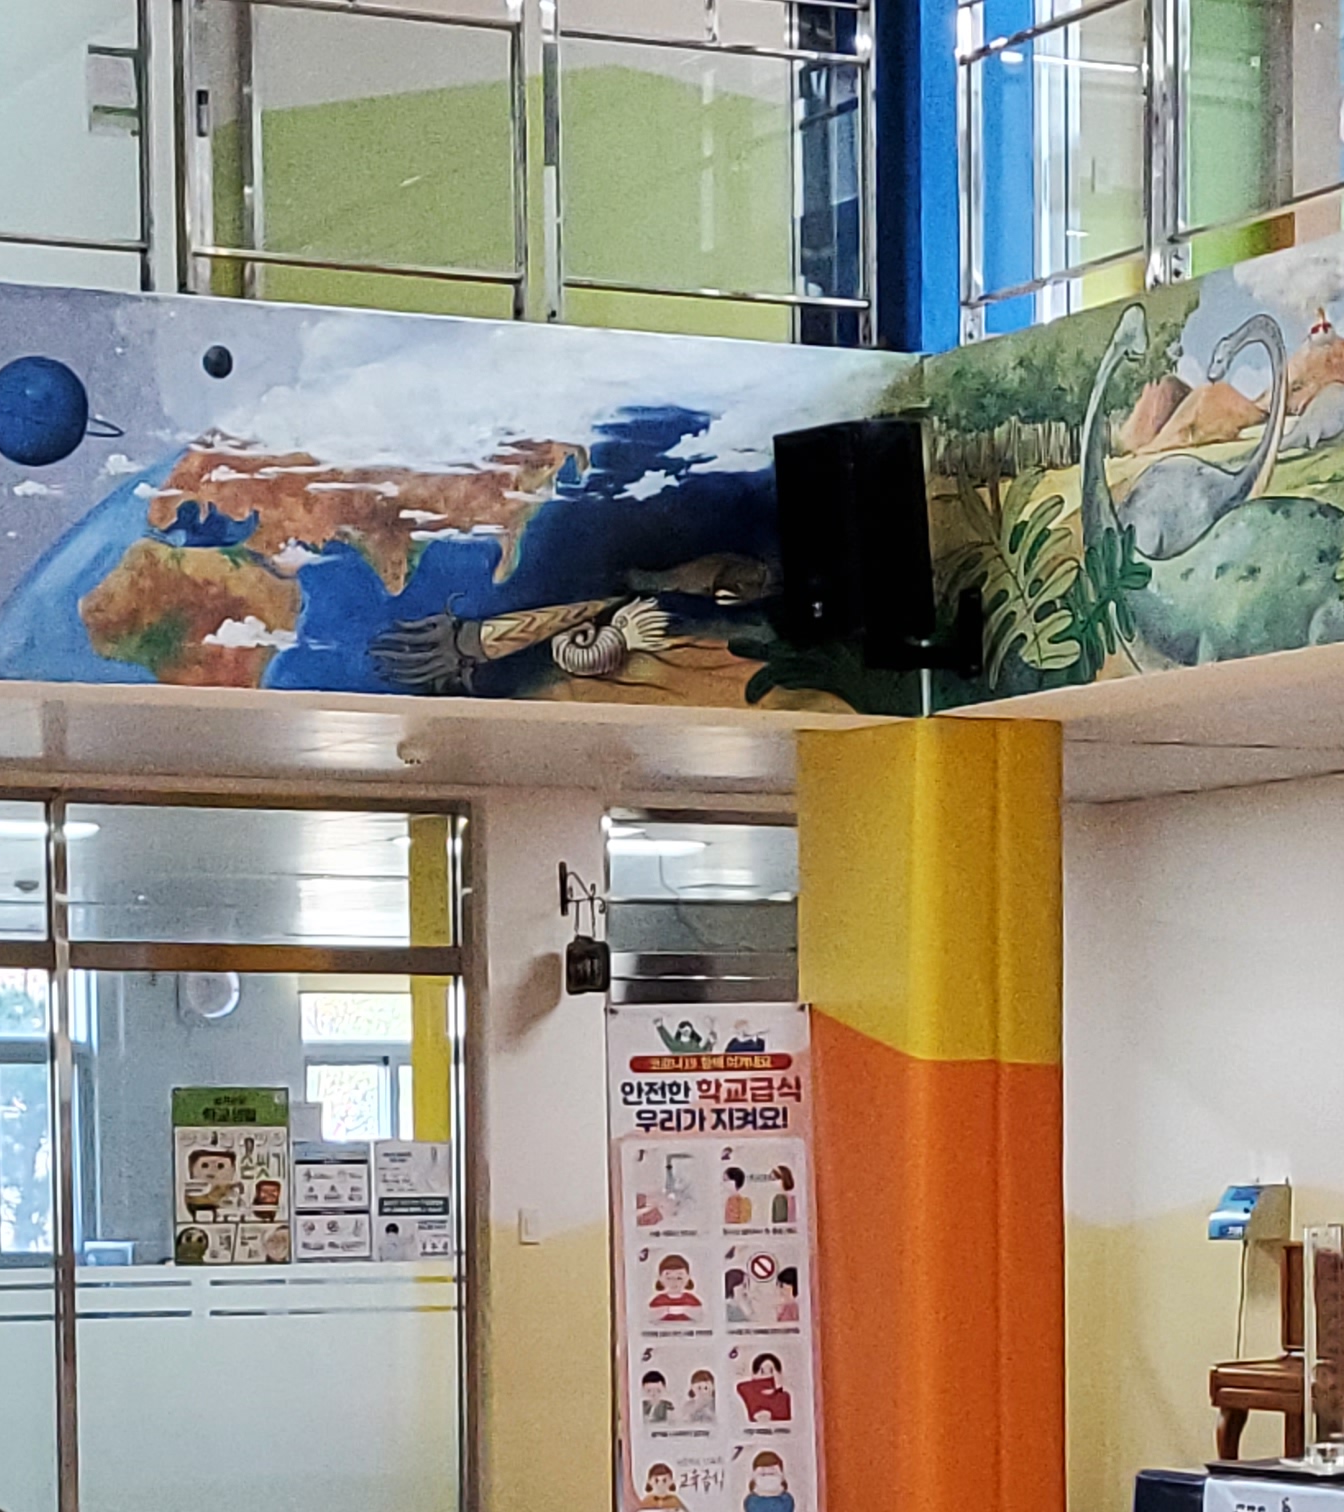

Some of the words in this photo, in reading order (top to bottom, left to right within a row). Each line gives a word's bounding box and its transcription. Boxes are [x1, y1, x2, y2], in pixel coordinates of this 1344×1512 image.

[621, 1081, 691, 1105] 안전한
[696, 1076, 802, 1104] 학교급식
[635, 1107, 706, 1133] 우리가
[711, 1106, 788, 1131] 지켜요!
[721, 1147, 733, 1160] 2
[639, 1248, 650, 1262] 3
[724, 1246, 736, 1260] 4
[642, 1347, 654, 1361] 5
[728, 1346, 739, 1360] 6
[731, 1445, 744, 1461] 7
